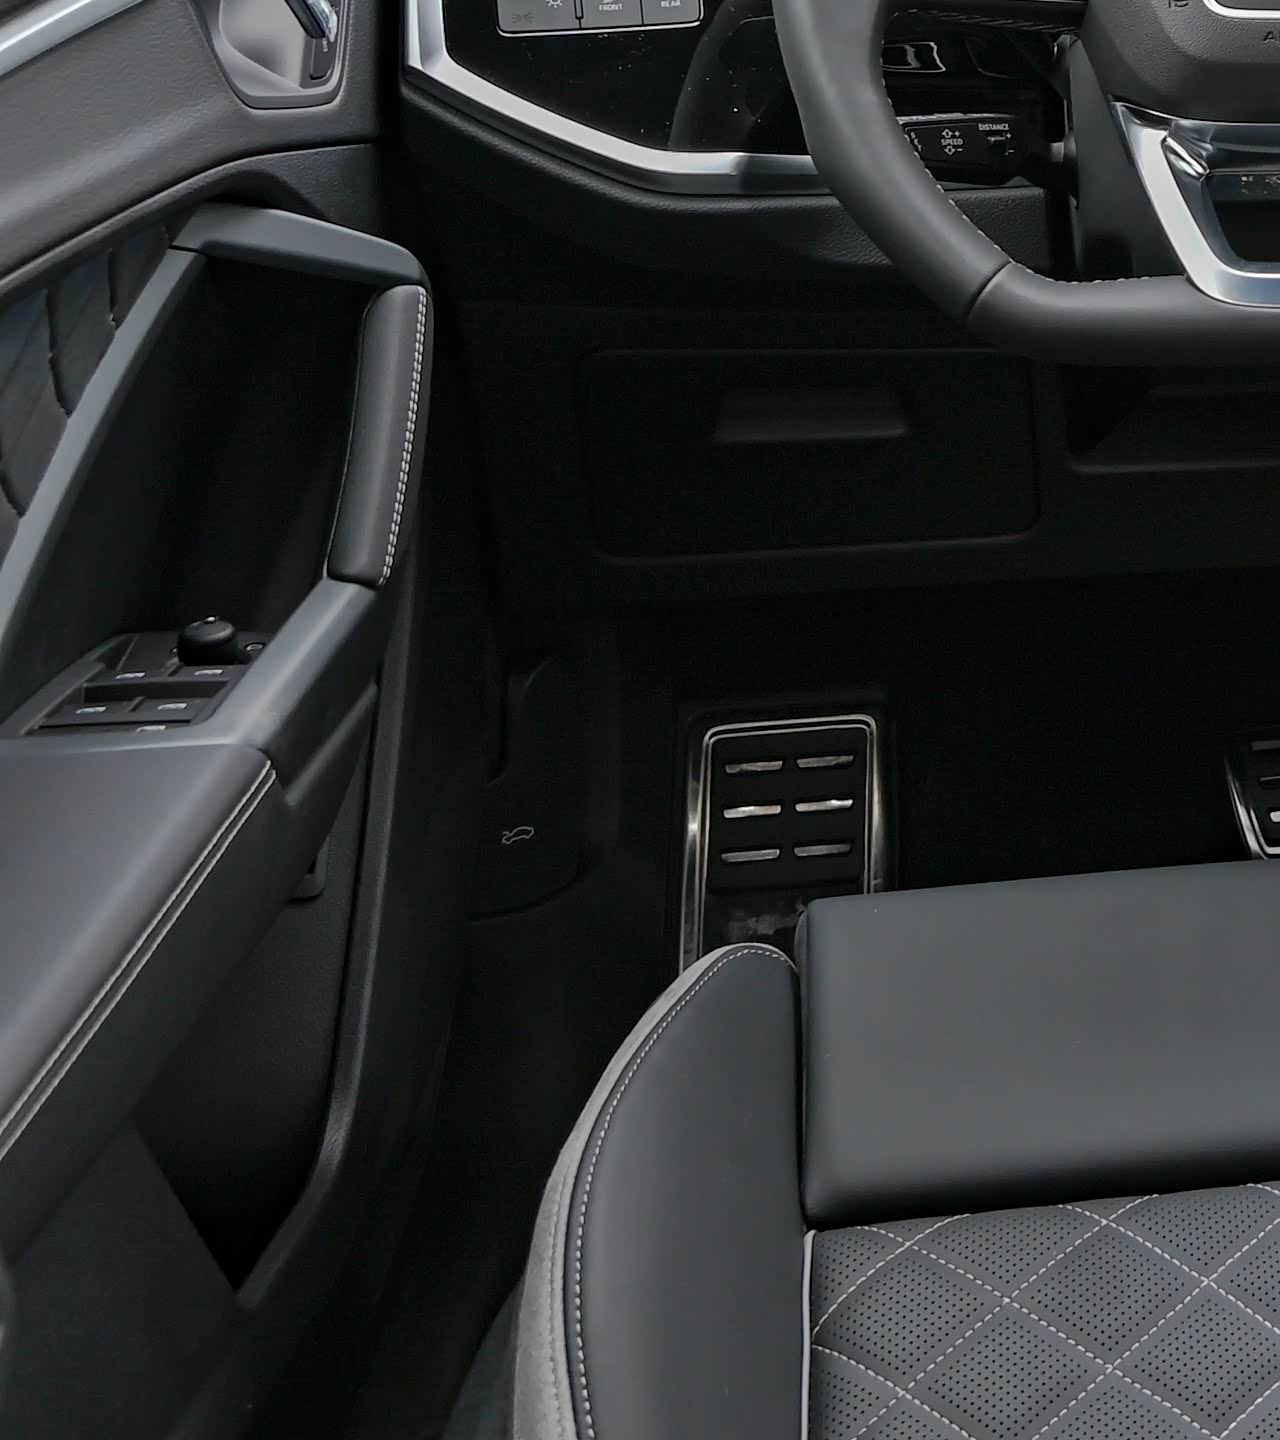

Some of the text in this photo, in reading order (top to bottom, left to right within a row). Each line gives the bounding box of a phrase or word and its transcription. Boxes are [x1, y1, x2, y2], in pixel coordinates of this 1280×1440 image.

[661, 0, 681, 8] REAR
[978, 123, 1010, 131] DISTANCE
[941, 138, 964, 146] SPEED
